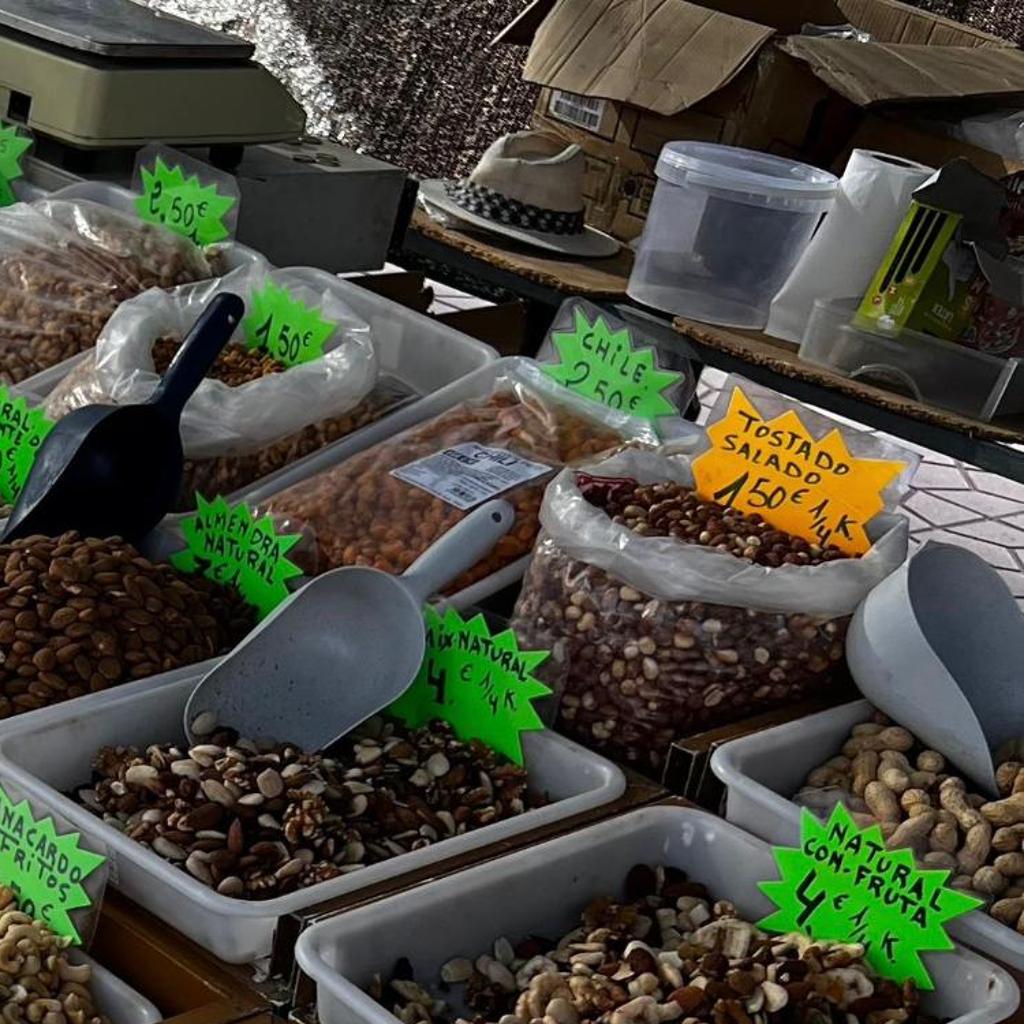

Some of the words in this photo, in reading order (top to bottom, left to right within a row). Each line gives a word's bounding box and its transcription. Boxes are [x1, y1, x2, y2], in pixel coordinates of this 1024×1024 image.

[721, 434, 822, 486] SALADO
[738, 410, 850, 477] TOSTADO
[195, 511, 280, 565] ALMENDRA
[204, 531, 275, 585] NATURAL
[457, 630, 528, 682] NATURAL
[828, 822, 942, 913] NATURAL
[853, 865, 928, 929] FRUTA
